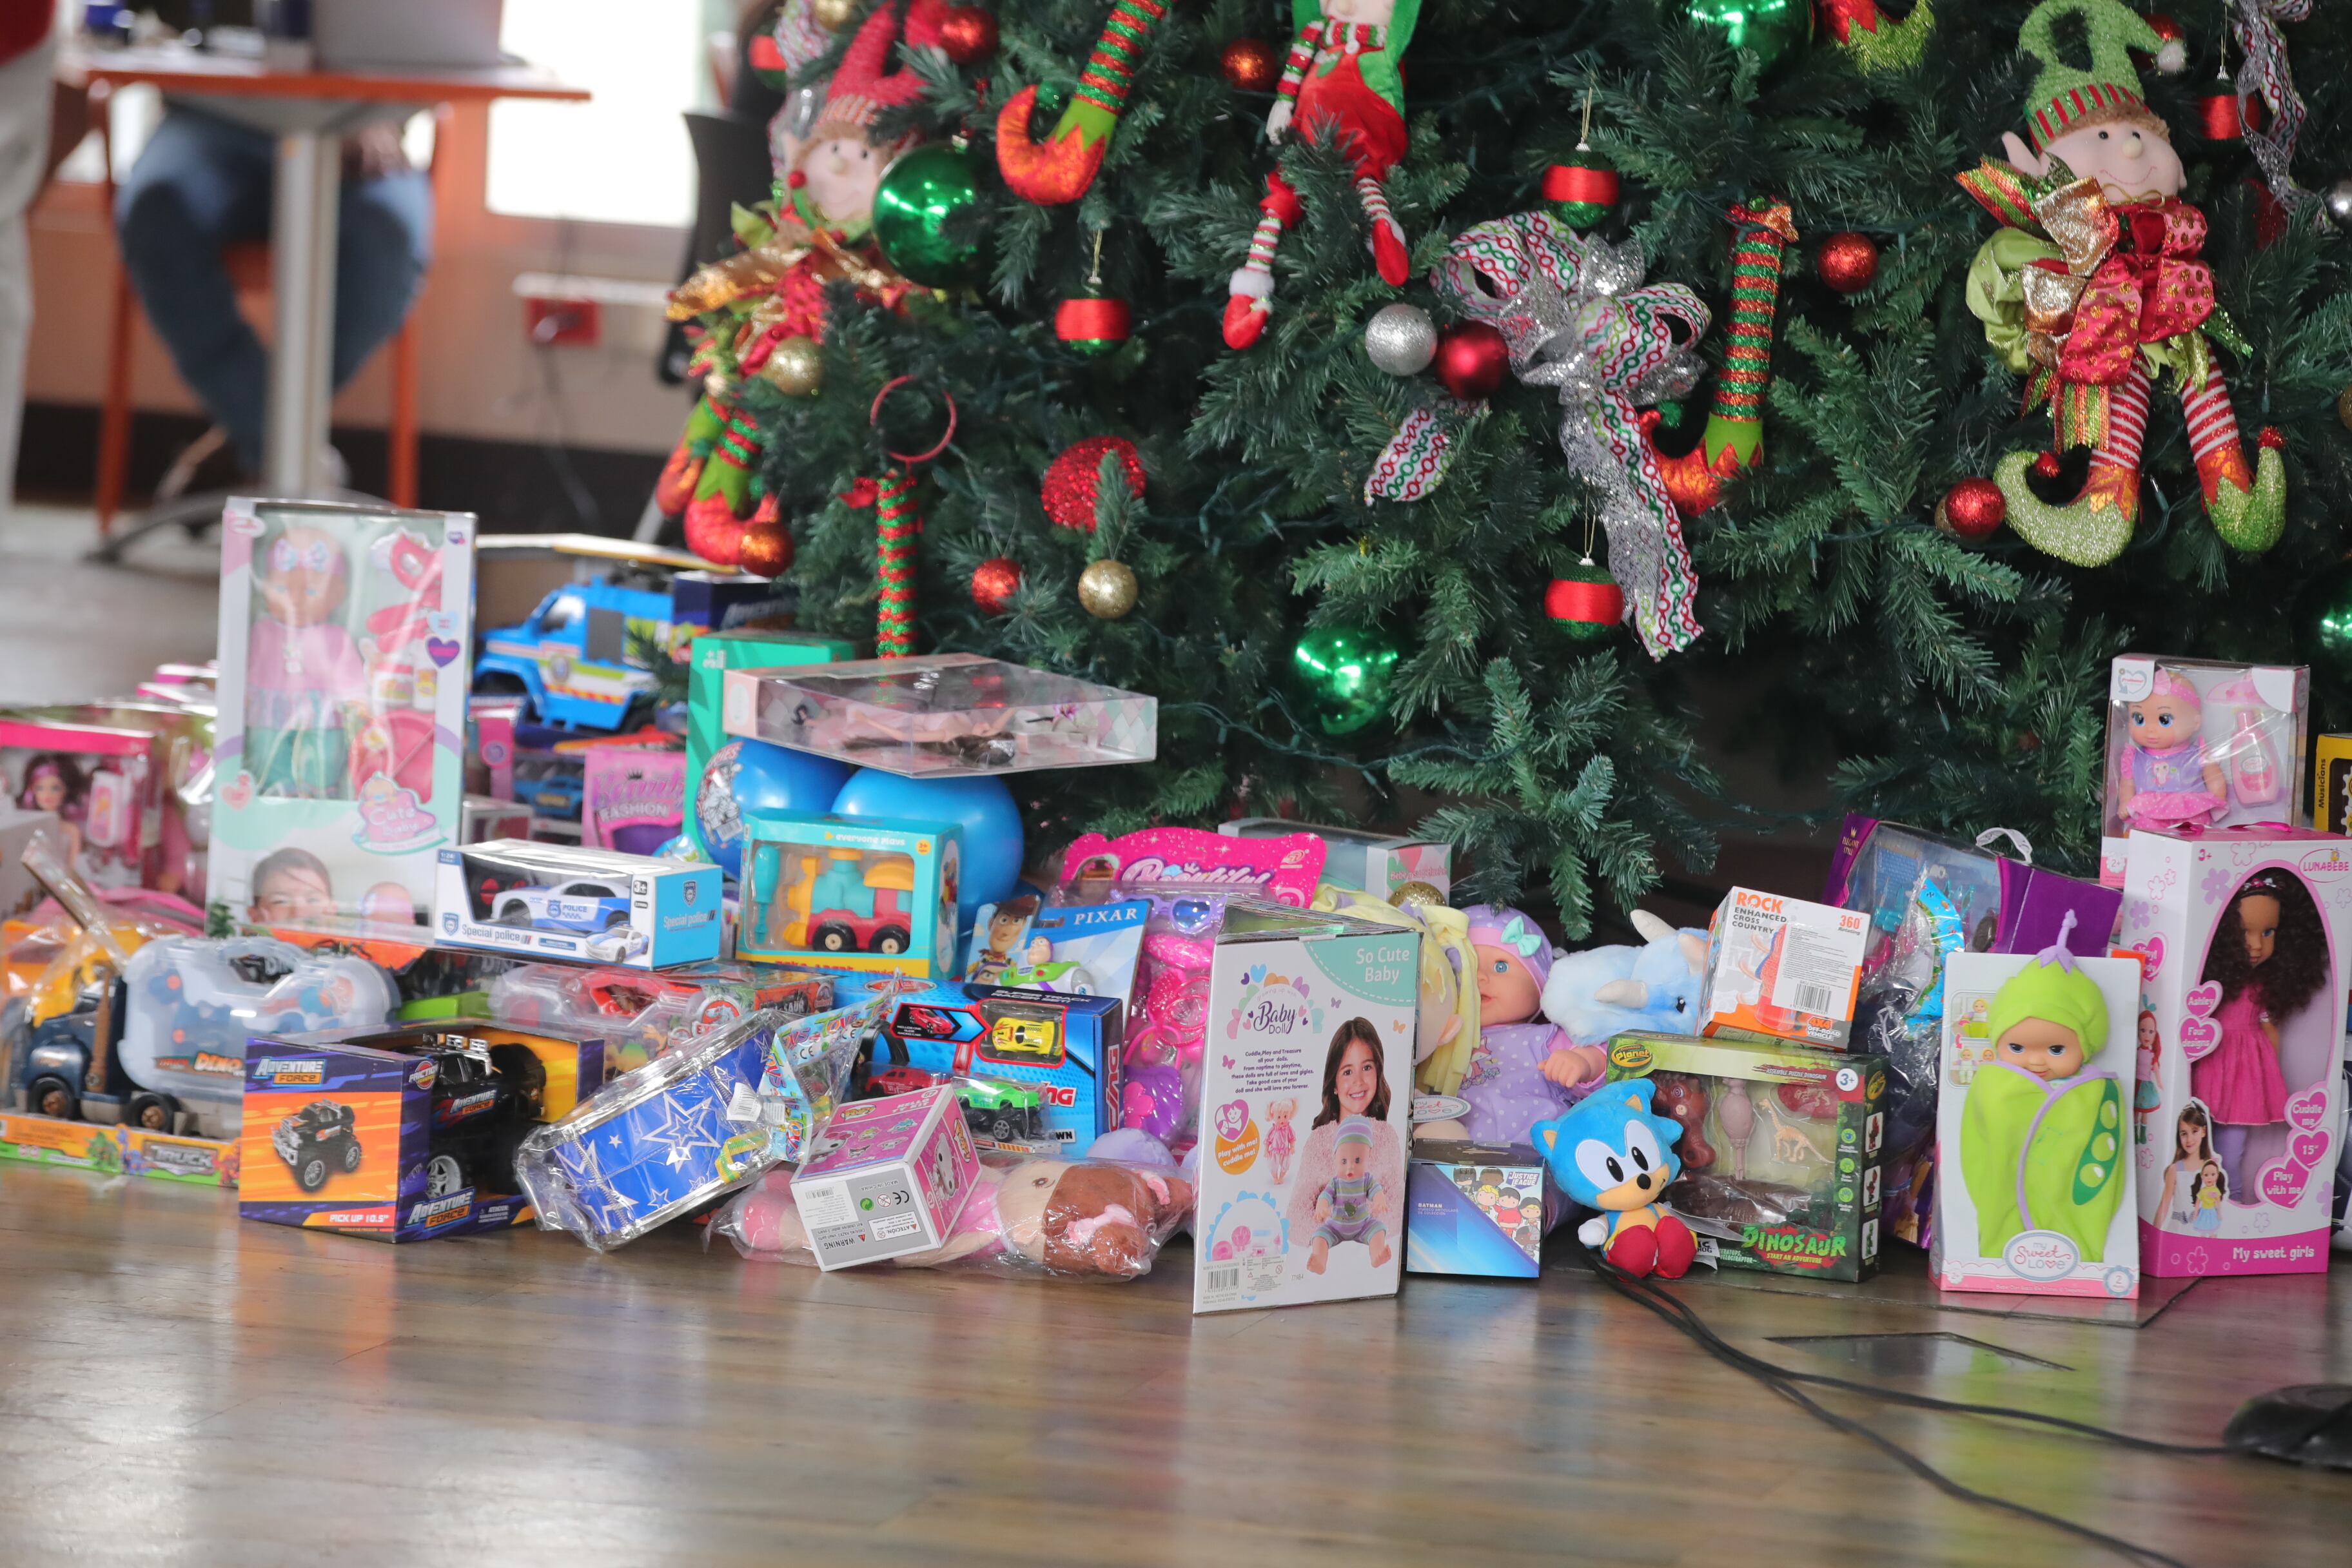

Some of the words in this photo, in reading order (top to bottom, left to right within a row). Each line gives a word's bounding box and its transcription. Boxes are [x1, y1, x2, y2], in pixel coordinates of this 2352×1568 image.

[2317, 758, 2326, 808] Musicians
[598, 804, 669, 822] FASHION
[1842, 836, 1860, 849] ELEGANT
[2198, 848, 2212, 861] 3+
[634, 881, 647, 894] 3+
[1736, 891, 1784, 914] ROCK
[663, 914, 687, 929] Special
[688, 910, 709, 926] police
[1073, 908, 1138, 925] PIXAR
[1733, 914, 1760, 924] CROSS
[1734, 906, 1787, 923] ENHANCED
[462, 924, 493, 939] Special
[495, 928, 520, 942] police
[1732, 921, 1774, 934] COUNTRY
[1838, 926, 1861, 936] Rotating
[1356, 948, 1373, 965] So
[1378, 946, 1410, 963] Cute
[1365, 966, 1400, 985] Baby
[1044, 994, 1092, 1003] TRACK
[2188, 996, 2215, 1008] Ashley
[1253, 1001, 1297, 1035] Baby
[1268, 1024, 1287, 1035] Doll
[1807, 1030, 1834, 1041] VEHICLE
[1808, 1026, 1841, 1037] OFF-ROAD
[2188, 1026, 2206, 1036] Four
[2182, 1037, 2211, 1050] designs
[1615, 1049, 1650, 1061] Planet
[194, 1052, 243, 1072] DINO
[255, 1057, 324, 1077] ADVENTURE
[409, 1063, 439, 1083] FRICTION
[1839, 1073, 1855, 1086] 3+
[450, 1089, 497, 1113] ADVENTURE
[2292, 1104, 2323, 1114] Cuddle
[2301, 1118, 2315, 1126] me
[1231, 1142, 1245, 1153] with
[1246, 1137, 1259, 1148] me!
[150, 1145, 213, 1168] TRUCK
[1222, 1154, 1243, 1166] cuddle
[1244, 1148, 1256, 1159] me!
[1509, 1171, 1539, 1180] JUSTICE
[2273, 1171, 2293, 1184] Play
[2266, 1185, 2286, 1195] with
[407, 1191, 473, 1225] ADVENTURE
[329, 1213, 349, 1223] PICK
[351, 1215, 363, 1223] UP
[823, 1237, 855, 1250] WARNING
[1742, 1226, 1847, 1257] DINOSAUR
[2032, 1242, 2048, 1250] my
[1792, 1255, 1822, 1264] ADVENTURE
[2014, 1245, 2072, 1266] Sweet
[2232, 1247, 2250, 1263] My
[2253, 1246, 2287, 1259] sweet
[2289, 1245, 2315, 1262] girls
[2115, 1275, 2122, 1284] 2
